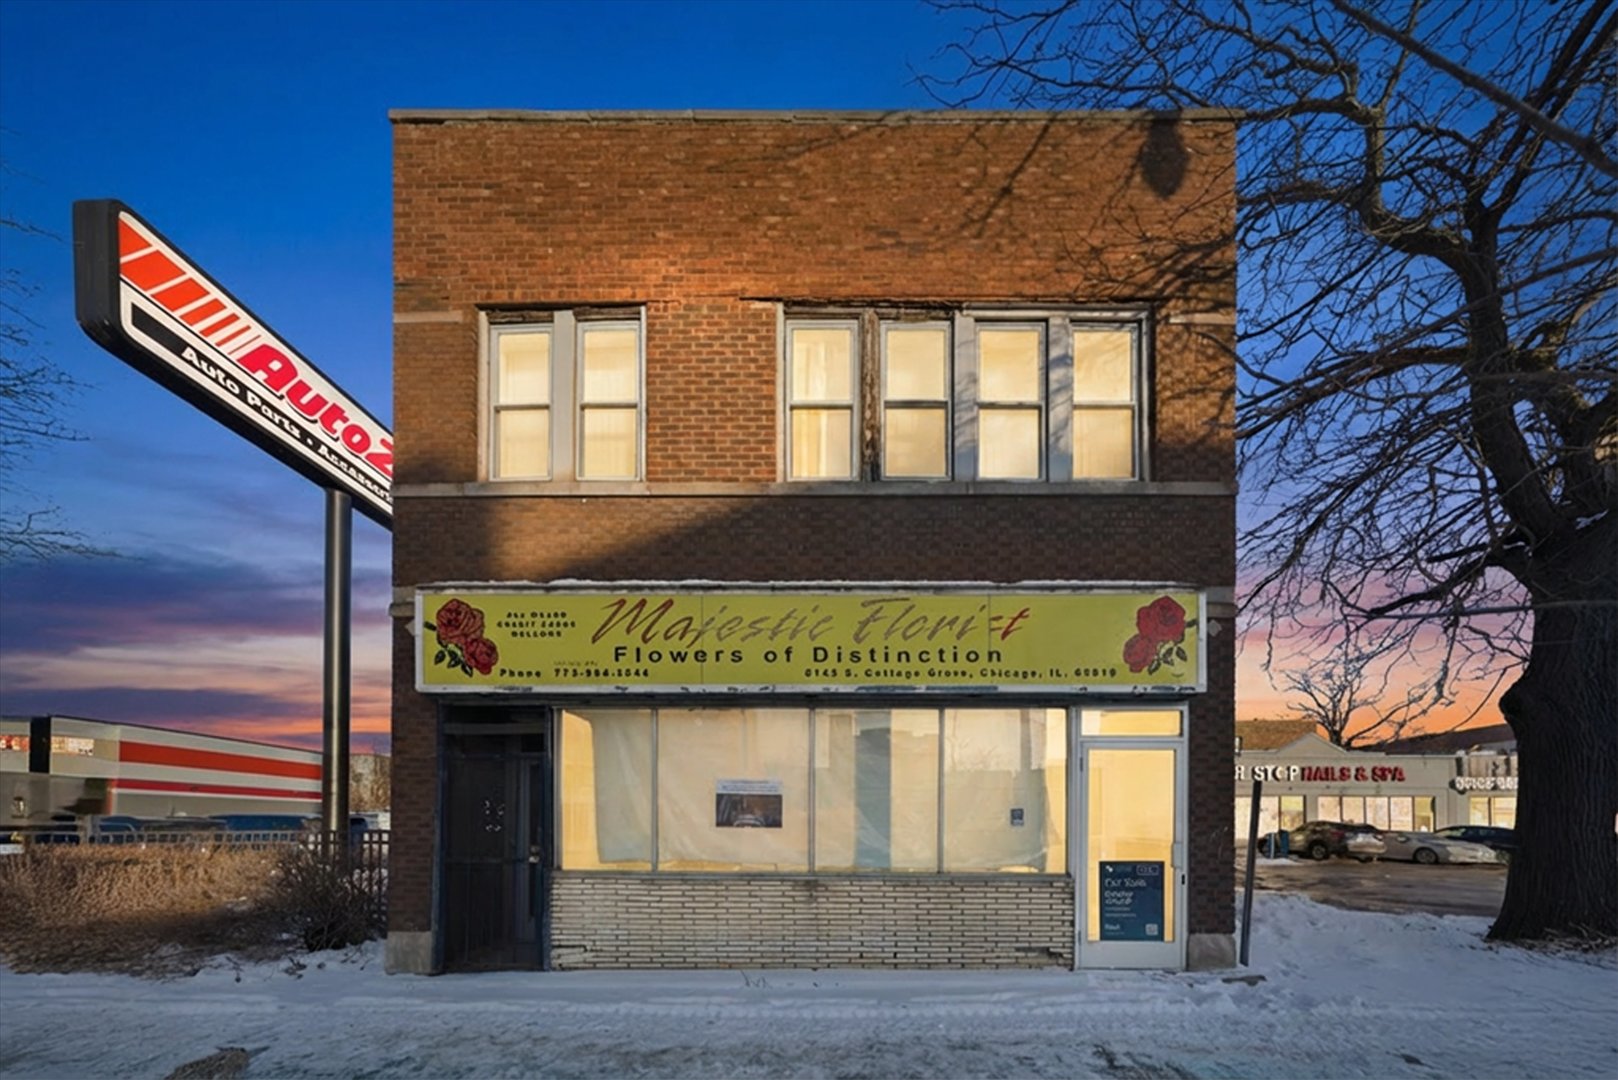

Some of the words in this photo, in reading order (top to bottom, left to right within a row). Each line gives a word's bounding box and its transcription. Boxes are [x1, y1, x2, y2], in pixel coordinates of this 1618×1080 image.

[181, 346, 240, 395] Auto
[245, 389, 302, 439] Parts
[592, 597, 835, 648] Majestic
[614, 646, 744, 663] Flowers
[764, 646, 794, 663] of
[813, 646, 1003, 663] Distinction
[499, 668, 542, 678] Phone
[864, 667, 921, 680] Cottage
[1253, 766, 1300, 781] STOP
[1302, 767, 1351, 782] NAILS
[1371, 767, 1406, 783] SPA
